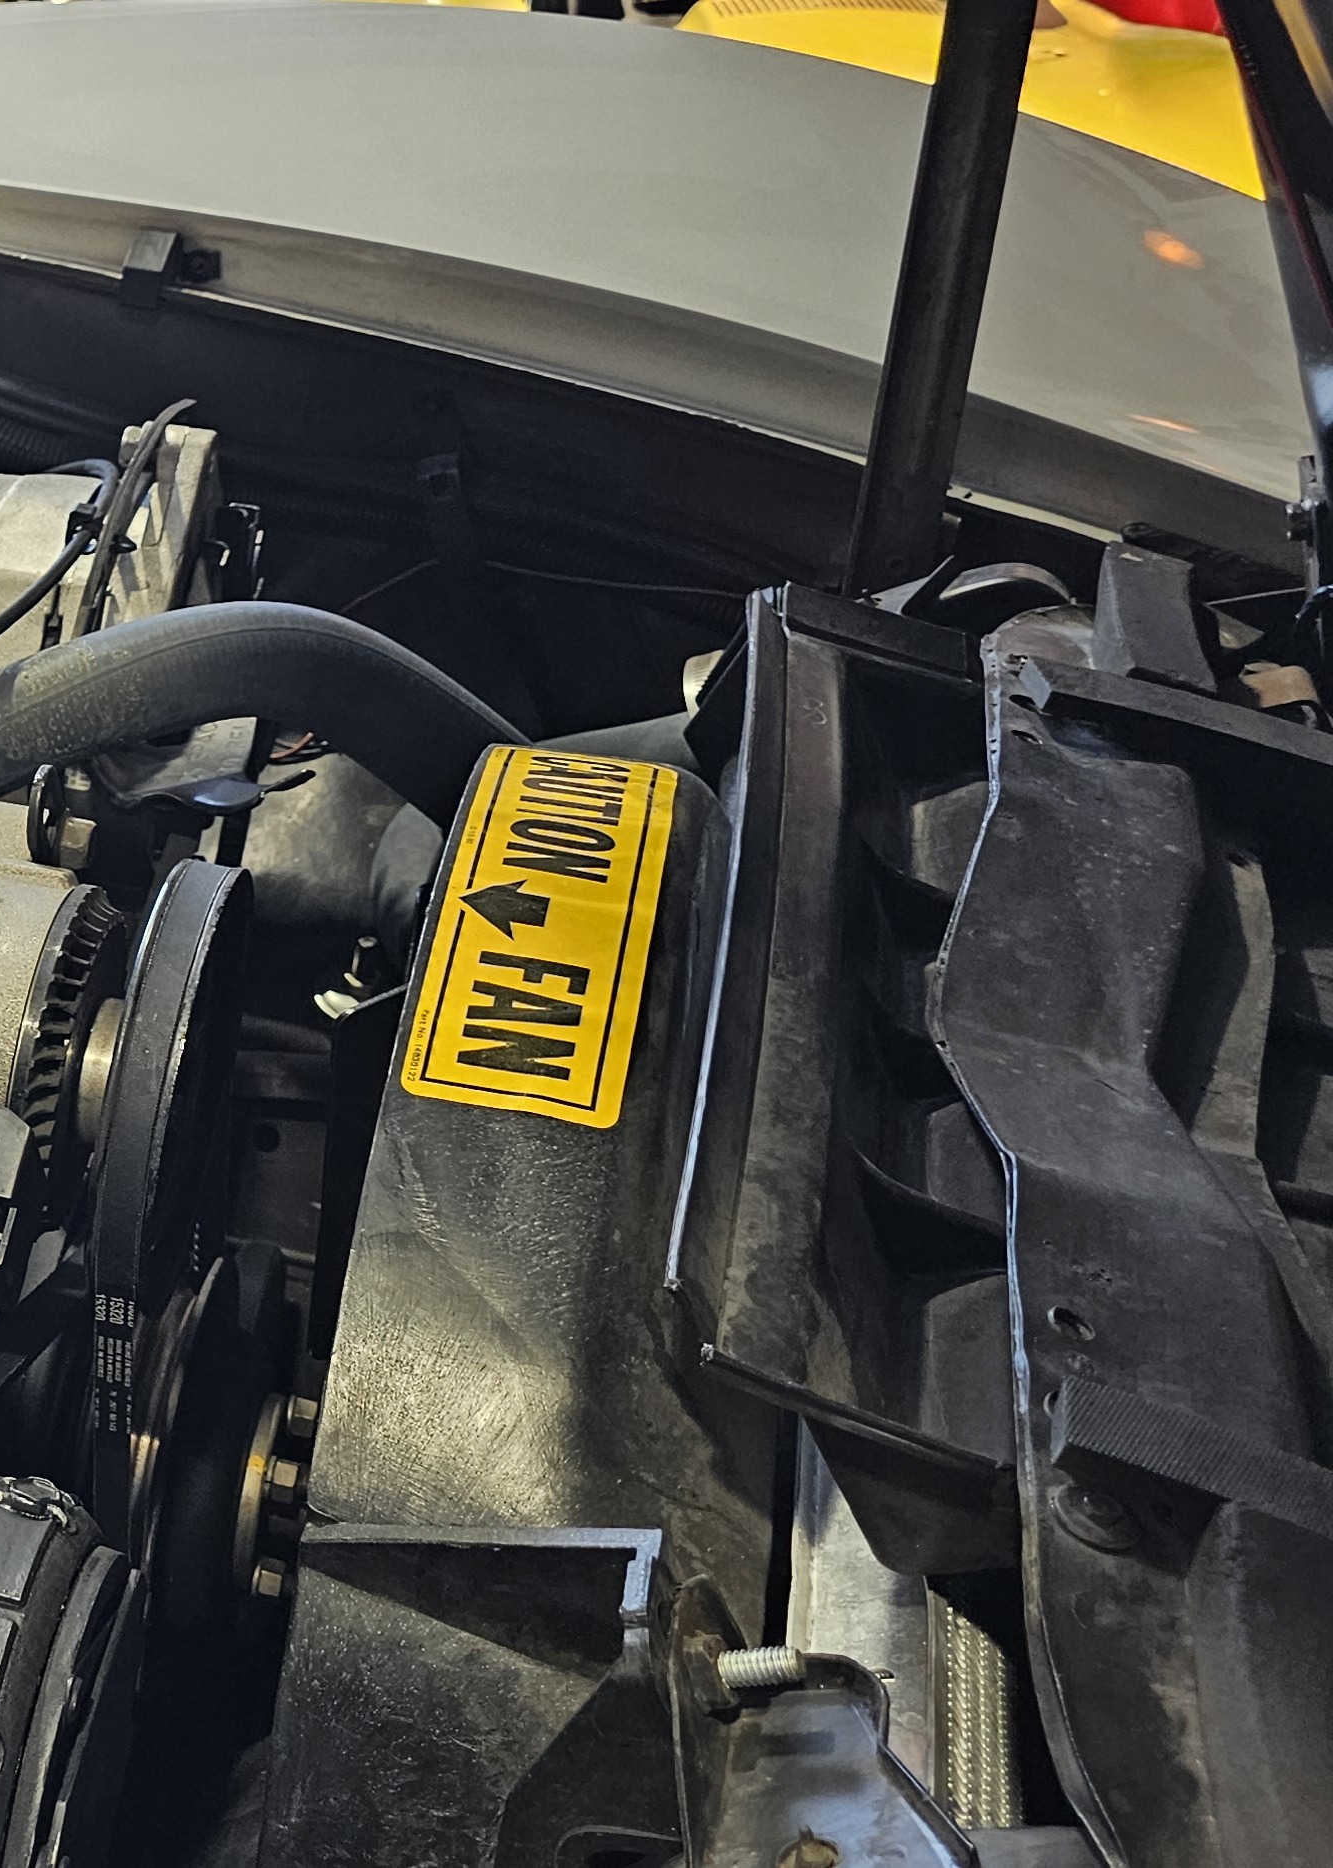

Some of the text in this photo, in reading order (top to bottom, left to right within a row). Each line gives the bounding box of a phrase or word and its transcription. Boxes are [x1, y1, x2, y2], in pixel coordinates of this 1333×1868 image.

[502, 754, 632, 883] CAUTION
[419, 1009, 431, 1025] Part
[457, 951, 591, 1081] FAN
[416, 1026, 427, 1040] No.
[109, 1296, 124, 1325] 15320
